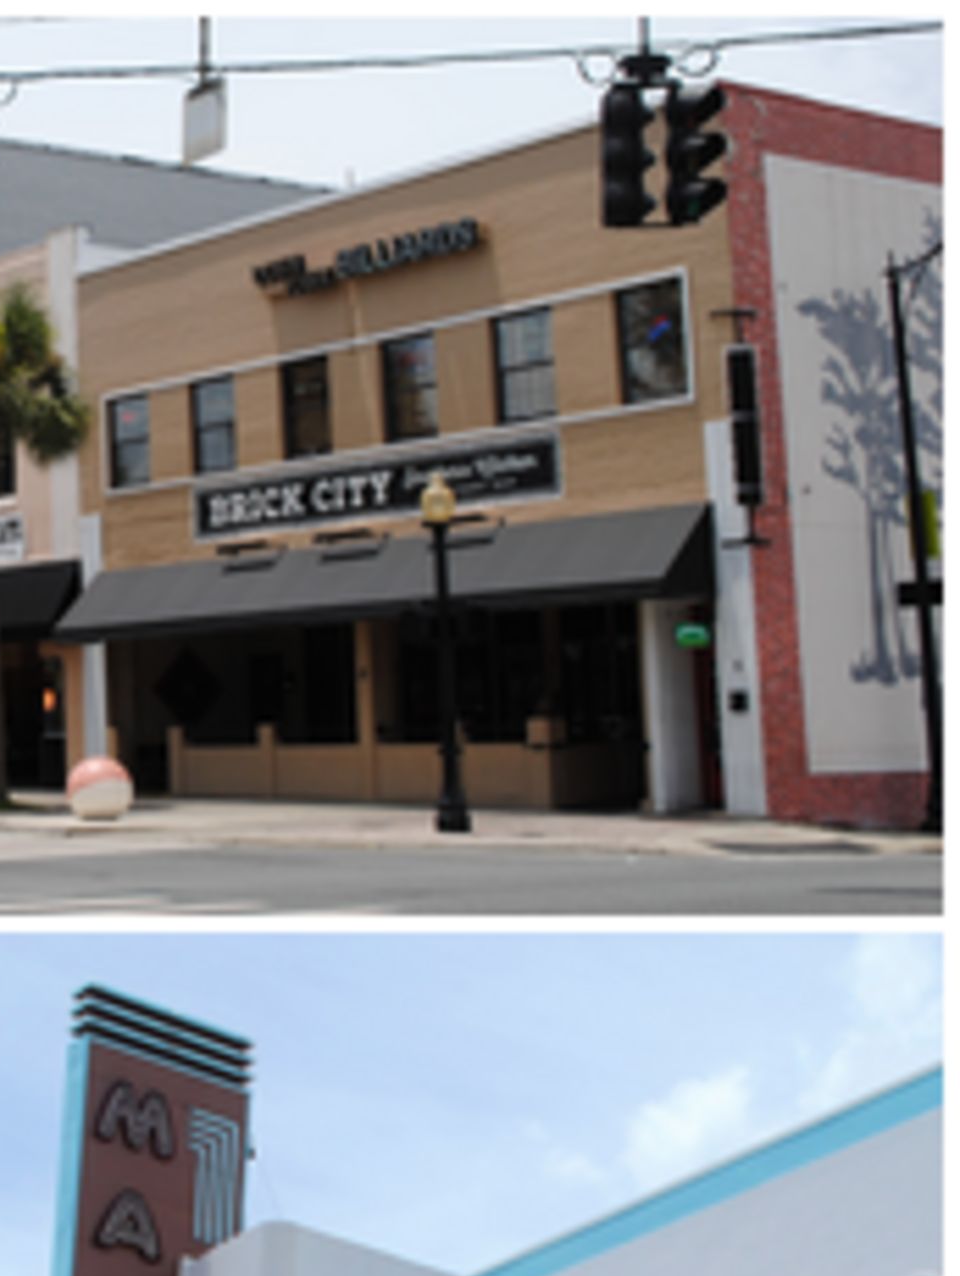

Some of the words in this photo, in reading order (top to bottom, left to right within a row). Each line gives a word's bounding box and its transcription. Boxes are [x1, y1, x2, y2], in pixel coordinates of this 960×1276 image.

[336, 216, 479, 278] BILLIARDS
[208, 480, 307, 528] BRICK
[309, 470, 394, 514] CITY
